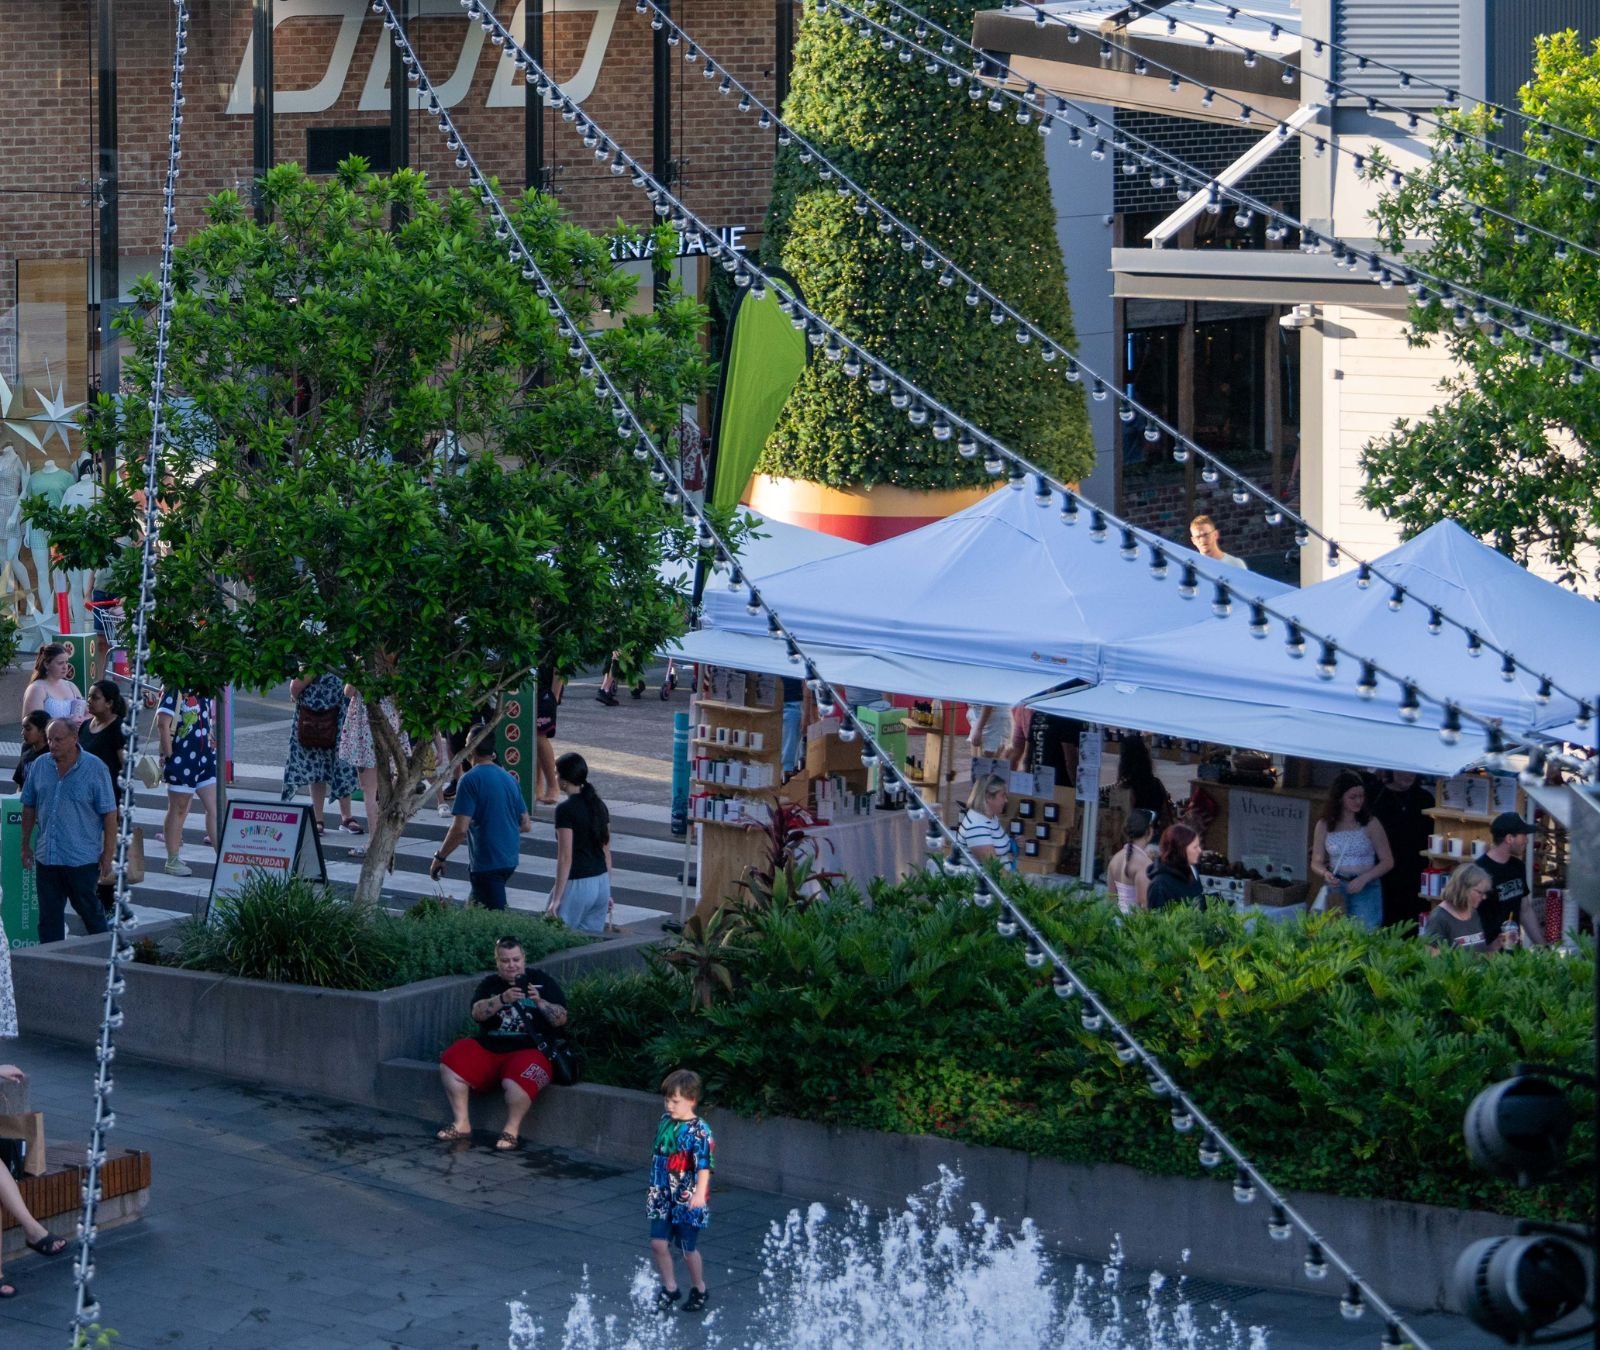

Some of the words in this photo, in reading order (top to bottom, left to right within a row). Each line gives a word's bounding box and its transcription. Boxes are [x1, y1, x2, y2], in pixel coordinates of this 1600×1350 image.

[676, 226, 746, 255] JAE
[243, 810, 254, 819] 1ST
[256, 811, 288, 821] SUNDAY
[1241, 796, 1304, 819] Alvearia
[226, 855, 245, 864] 2ND
[246, 857, 286, 868] SATURDAY
[21, 902, 30, 930] STREET
